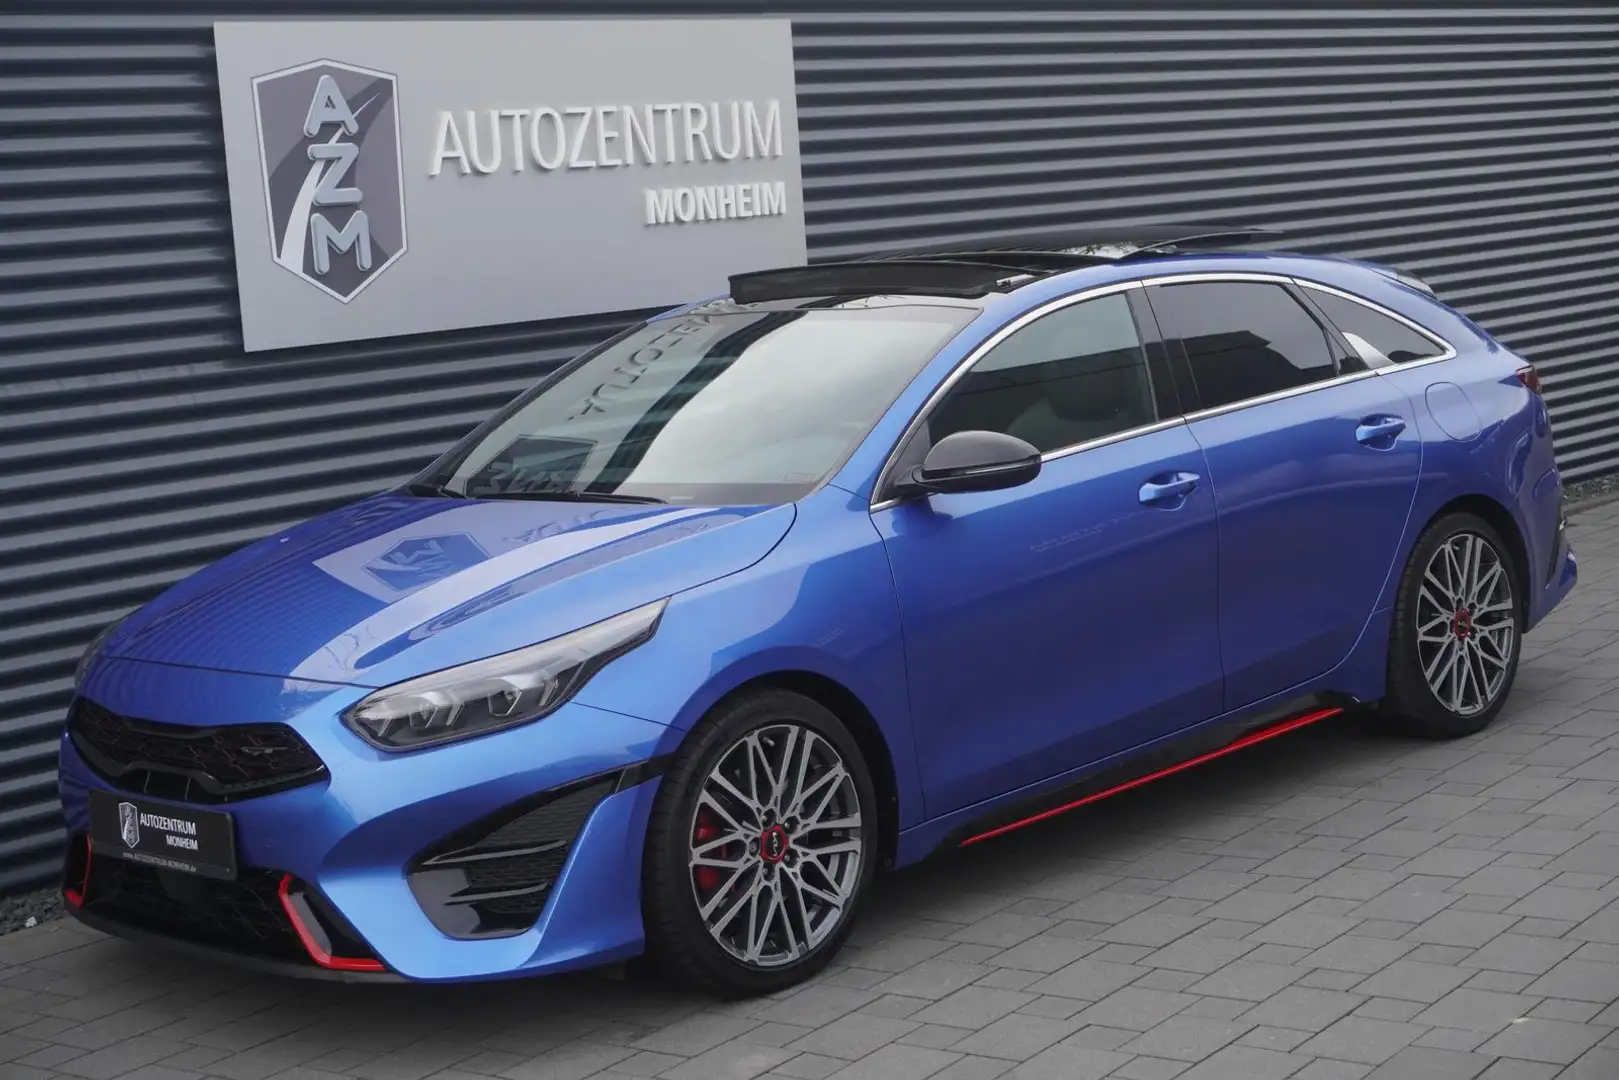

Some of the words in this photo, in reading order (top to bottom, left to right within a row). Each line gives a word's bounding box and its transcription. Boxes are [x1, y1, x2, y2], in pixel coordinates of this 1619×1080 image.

[429, 99, 784, 177] AUTOZENTRUM
[303, 74, 372, 275] AZM
[645, 181, 787, 225] MONHEIM
[139, 812, 197, 835] AUTOZENTRUM
[166, 835, 198, 851] MONHEIM
